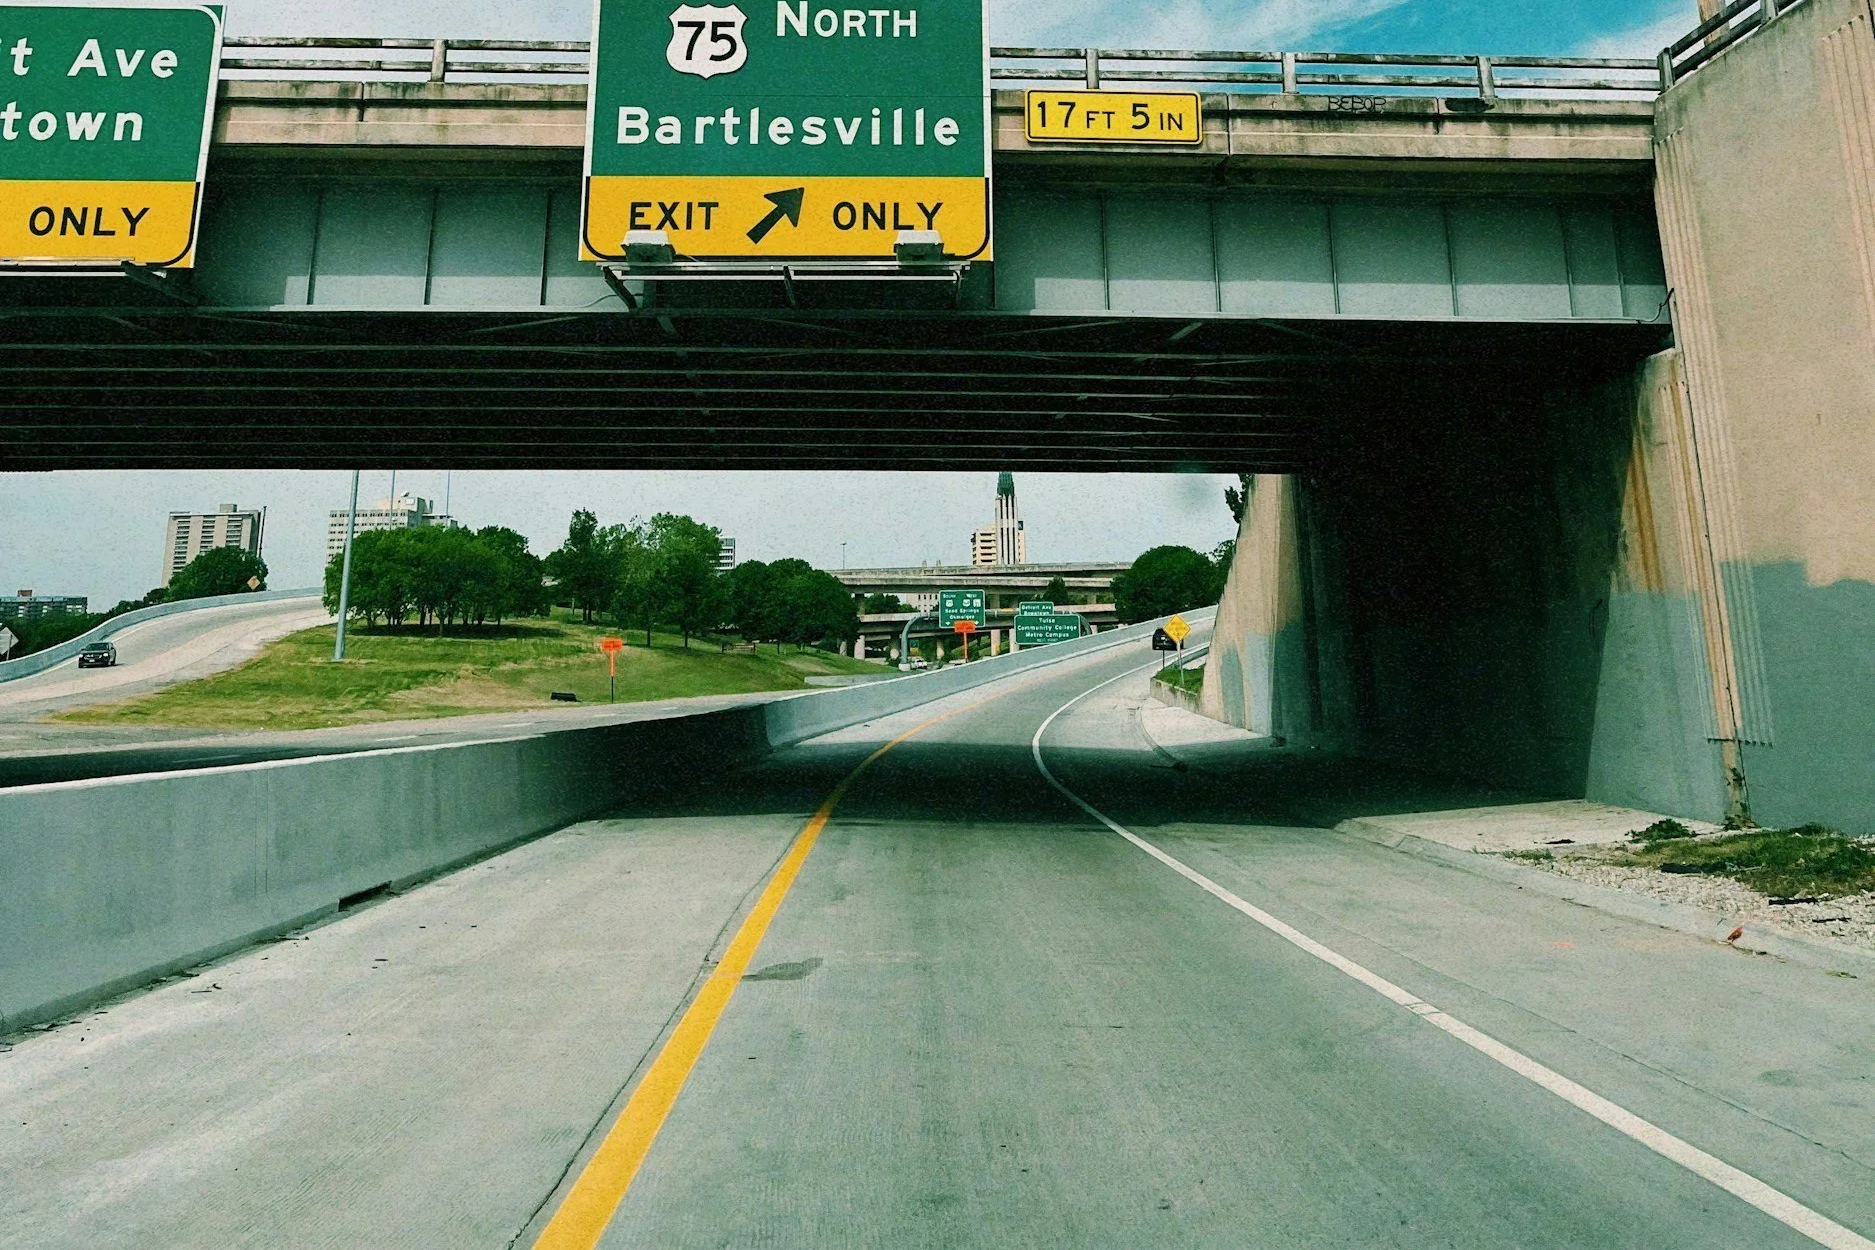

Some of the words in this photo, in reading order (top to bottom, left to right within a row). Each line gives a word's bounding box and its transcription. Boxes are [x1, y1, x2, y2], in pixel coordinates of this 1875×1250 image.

[67, 38, 178, 78] Ave
[677, 21, 737, 62] 75
[616, 106, 960, 146] Bartlesville
[1038, 101, 1076, 128] 17
[1086, 111, 1115, 129] FT
[1132, 103, 1150, 130] 5
[1160, 113, 1183, 131] IN
[29, 206, 150, 236] ONLY
[629, 202, 719, 231] EXIT
[832, 202, 944, 231] ONLY
